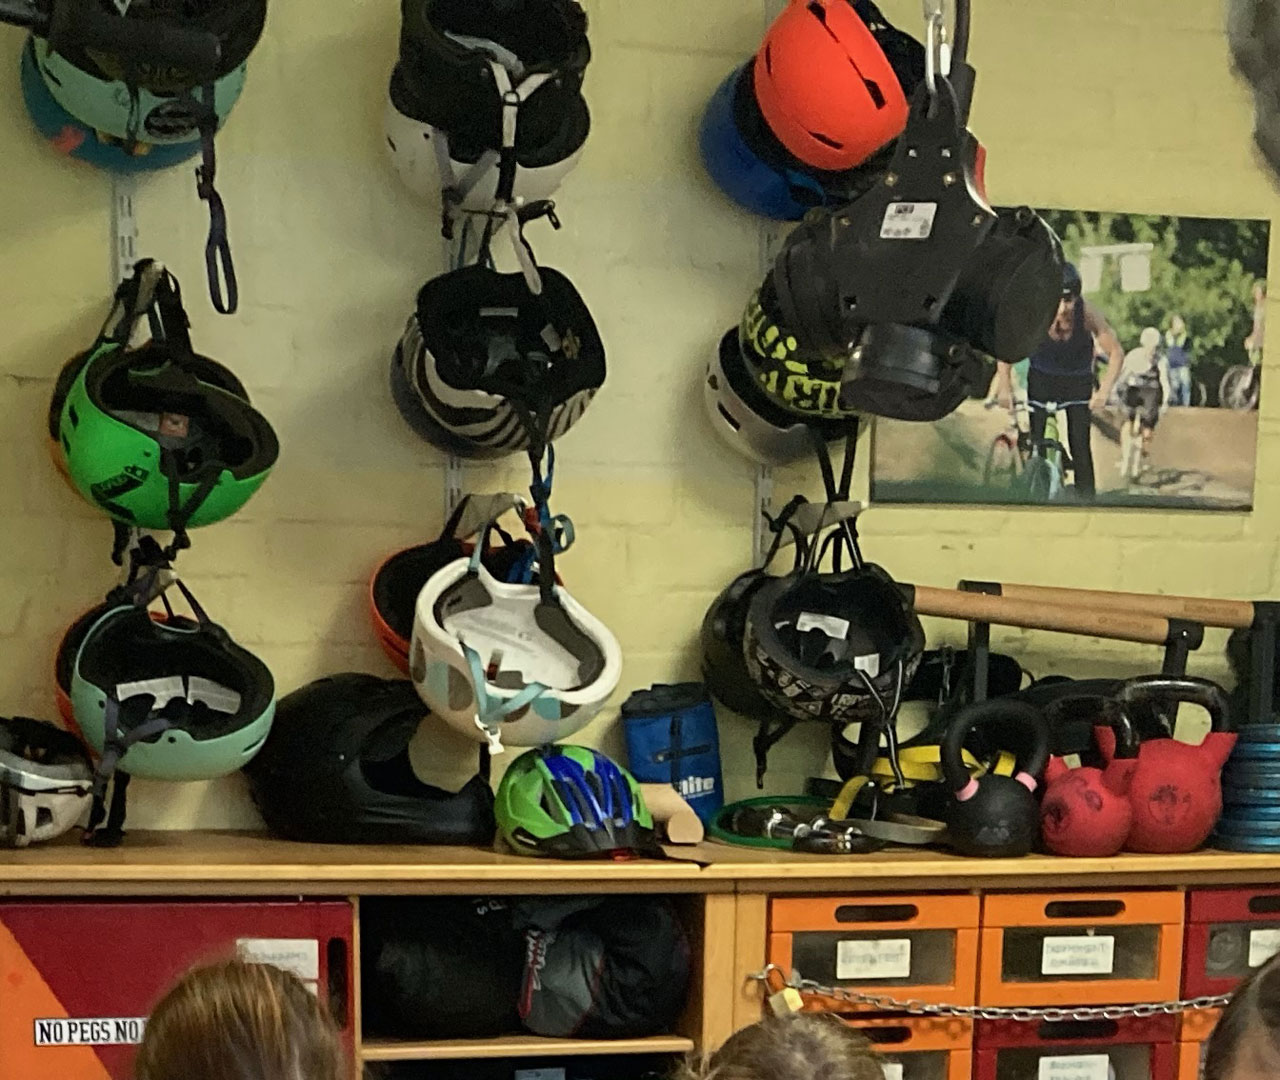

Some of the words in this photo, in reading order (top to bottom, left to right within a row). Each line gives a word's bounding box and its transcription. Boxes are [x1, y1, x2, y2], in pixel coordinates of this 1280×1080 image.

[39, 1021, 63, 1043] NO
[67, 1021, 111, 1042] PEGS
[114, 1021, 139, 1042] NO
